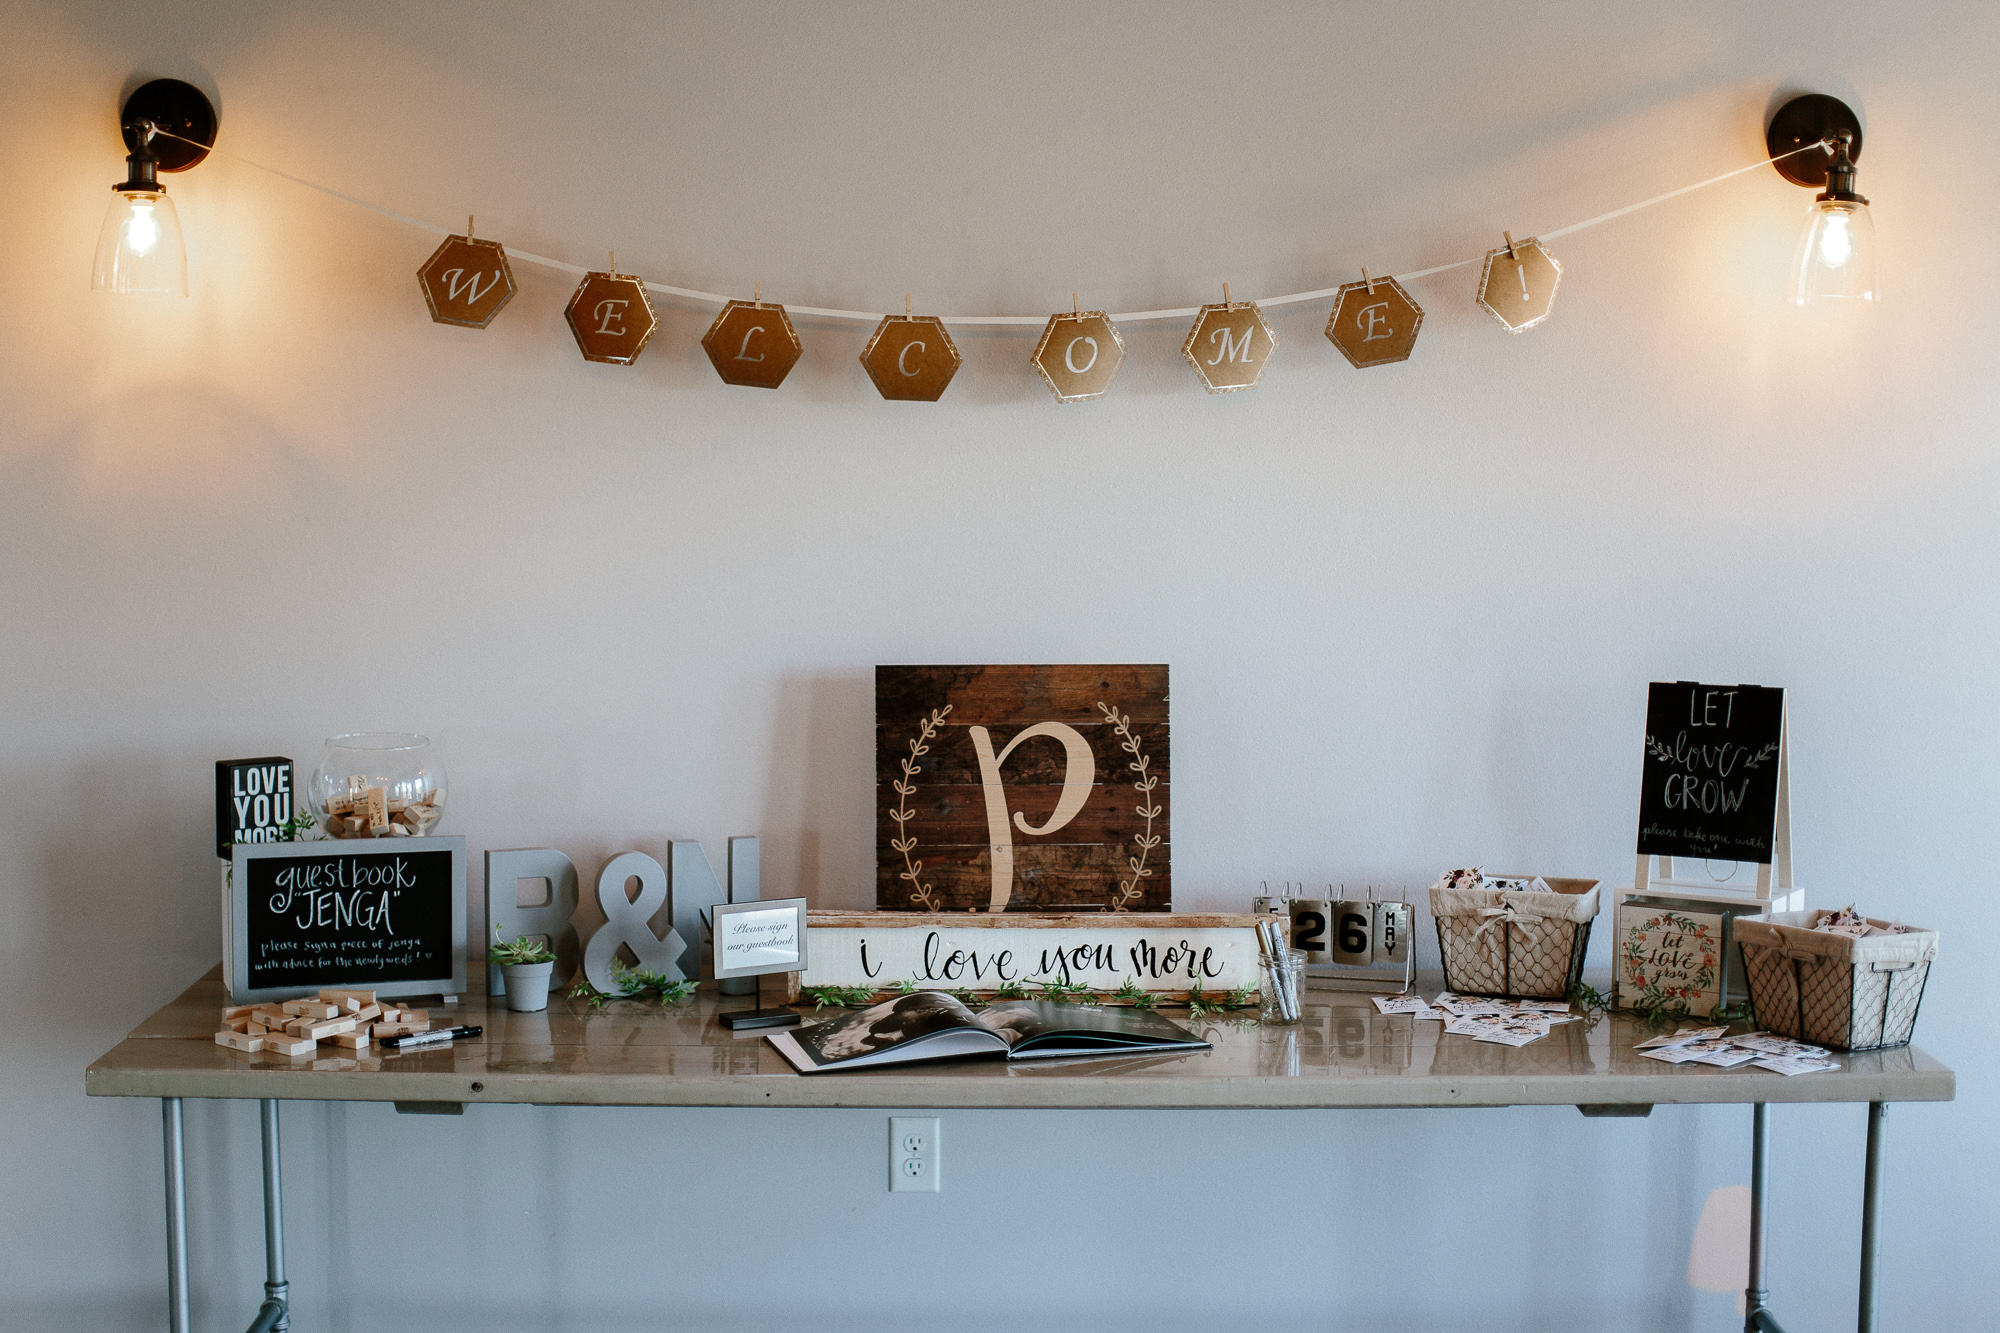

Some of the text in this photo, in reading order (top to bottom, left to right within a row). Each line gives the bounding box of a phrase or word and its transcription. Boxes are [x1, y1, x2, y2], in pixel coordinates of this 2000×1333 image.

[1690, 689, 1739, 729] LET
[1671, 730, 1747, 778] love
[233, 764, 290, 797] LOVE
[1664, 773, 1750, 814] GROW
[233, 792, 290, 829] YOU
[484, 836, 761, 998] B&N
[732, 921, 788, 935] Please sign
[1295, 911, 1368, 954] 26
[1384, 911, 1396, 956] MAY
[261, 939, 298, 958] please
[341, 940, 367, 951] piece
[372, 938, 385, 949] of
[388, 938, 421, 951] jenga
[727, 934, 794, 953] our guestbook
[1661, 931, 1685, 949] let
[254, 959, 279, 970] with
[283, 958, 315, 969] advice
[318, 957, 332, 969] for
[335, 956, 352, 968] the
[859, 931, 1225, 986] i love you more
[1648, 947, 1698, 970] LOVE
[1650, 968, 1691, 985] grow
